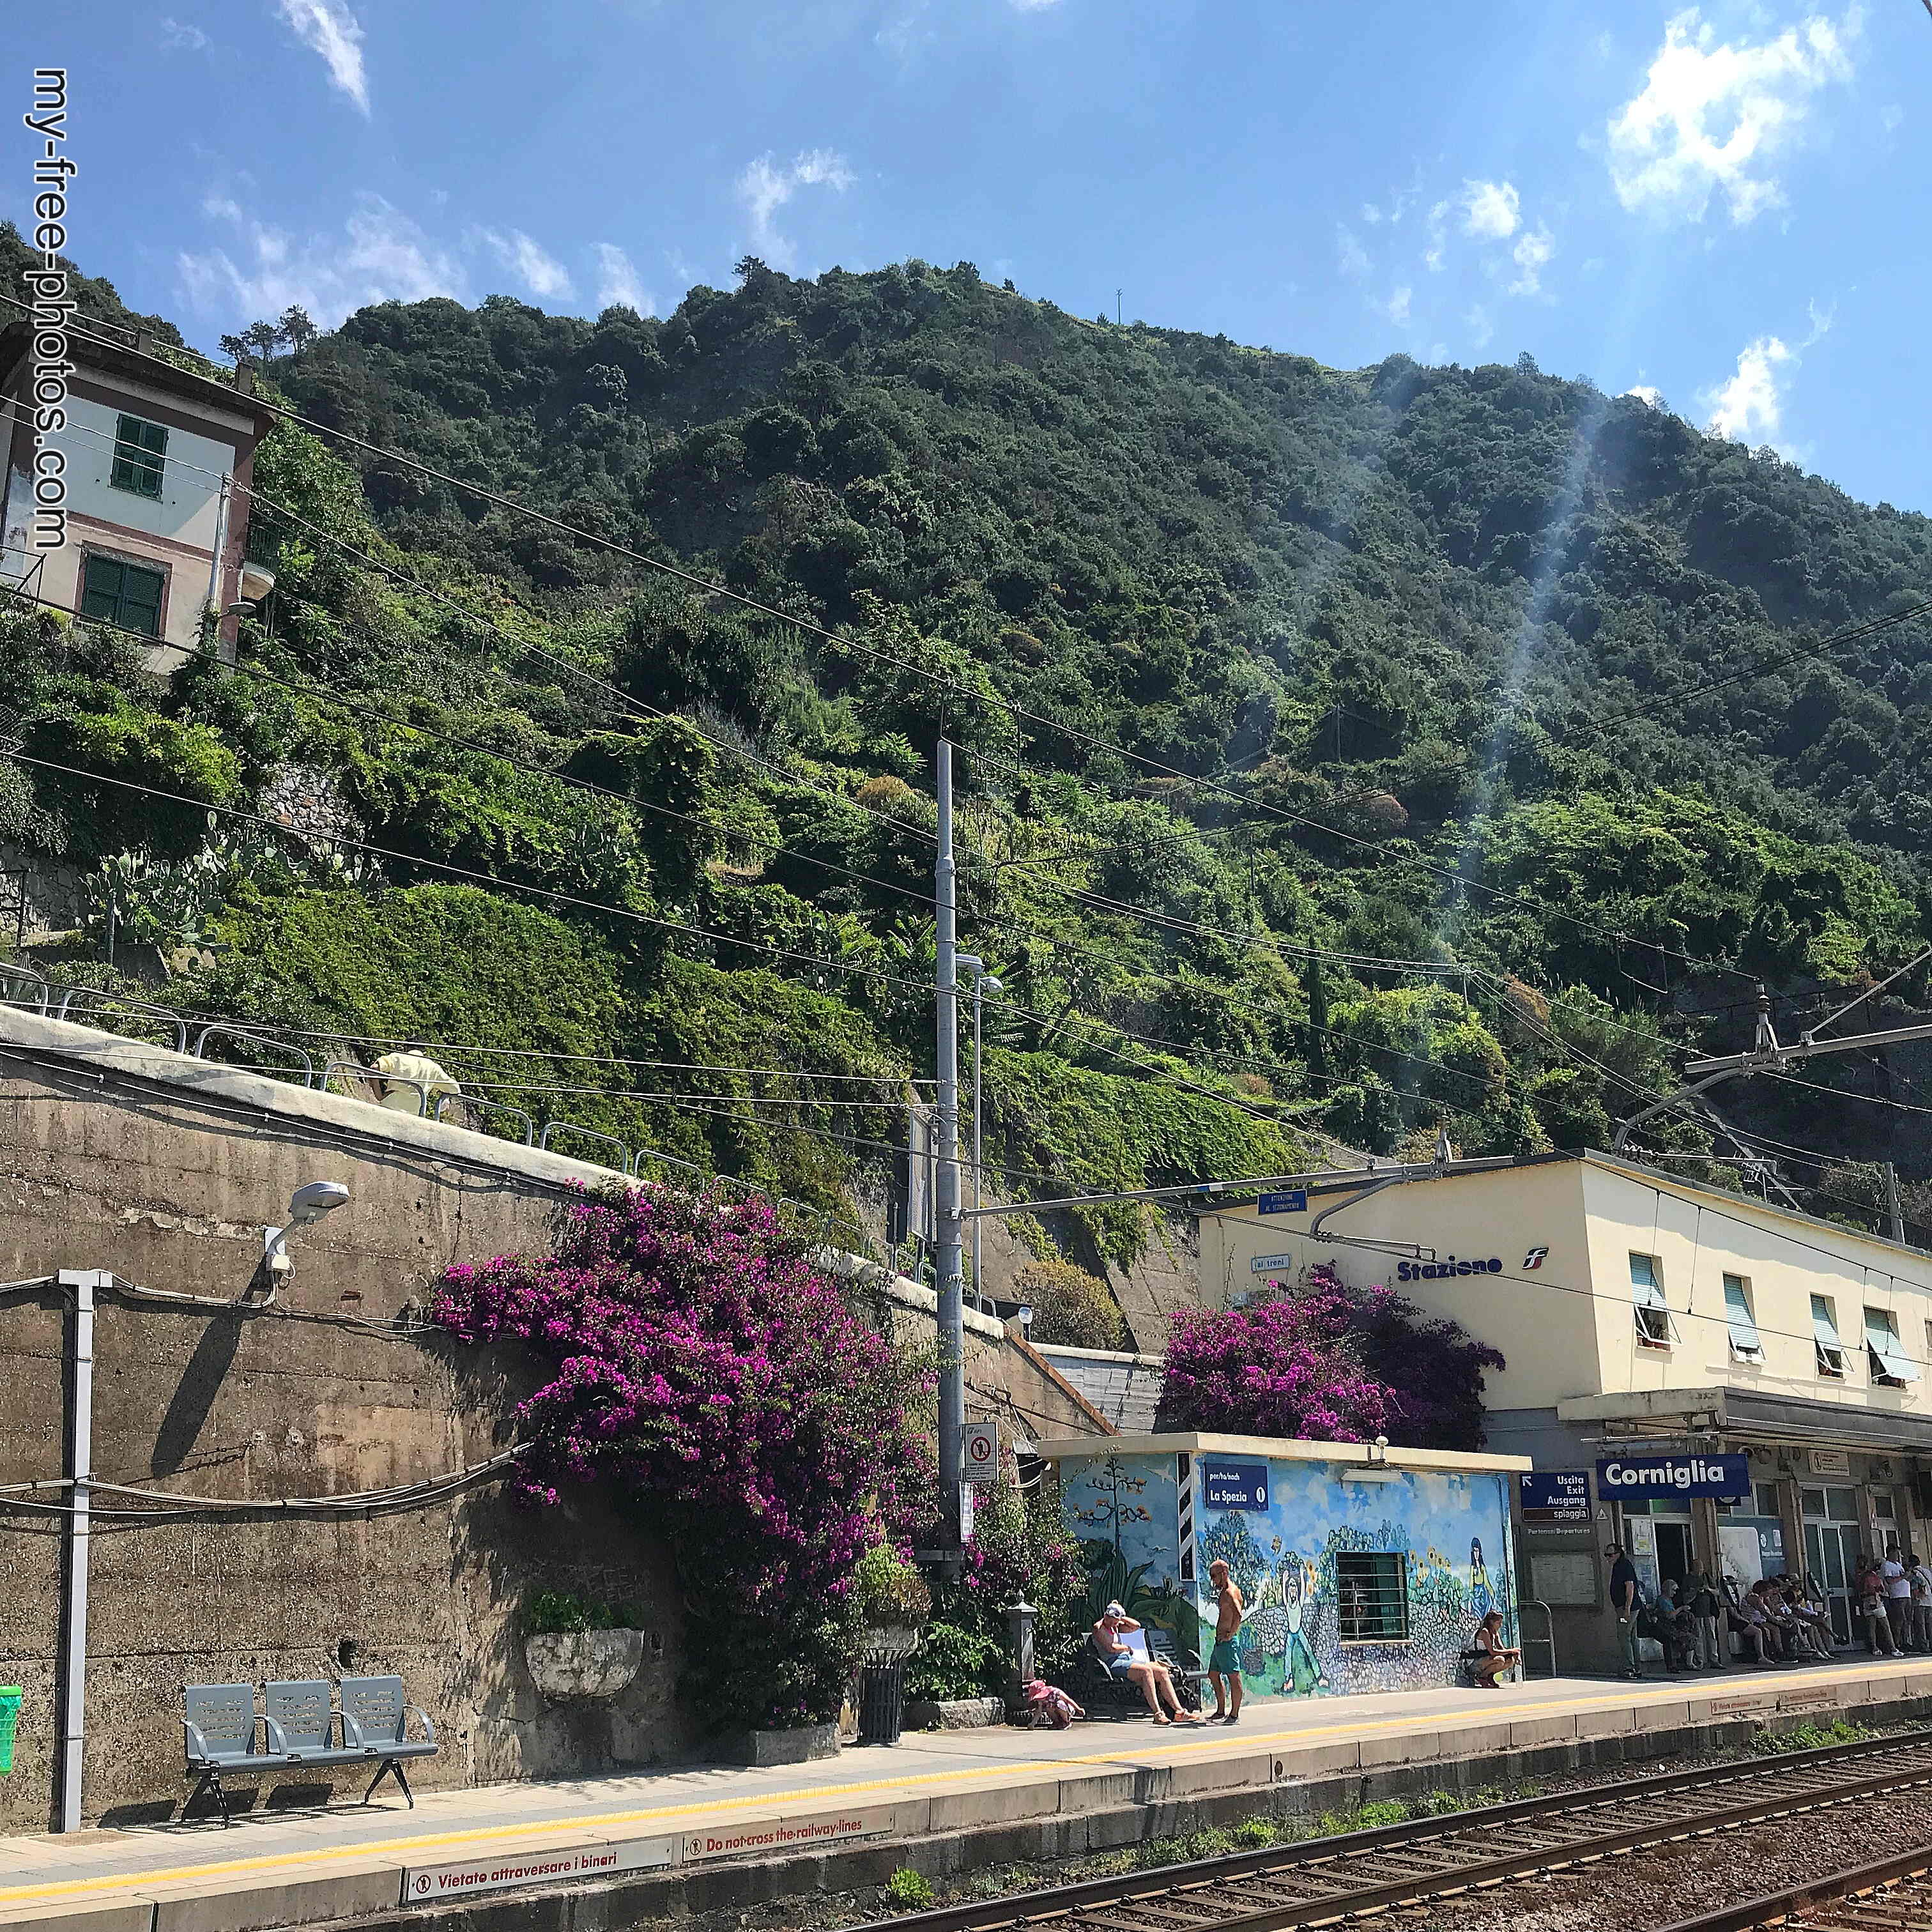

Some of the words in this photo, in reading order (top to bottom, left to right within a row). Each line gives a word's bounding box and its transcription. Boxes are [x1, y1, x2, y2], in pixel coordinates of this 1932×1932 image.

[1397, 1255, 1503, 1281] Stazione
[1557, 1475, 1584, 1484] Uscita
[1606, 1460, 1724, 1489] Corniglia
[1567, 1485, 1584, 1494] Exit
[1210, 1490, 1220, 1501] La
[1222, 1490, 1247, 1505] Spezia
[1547, 1496, 1586, 1506] Ausgang
[1554, 1508, 1586, 1519] spiaggia
[707, 1838, 723, 1852] Do
[725, 1836, 744, 1849] not
[746, 1832, 774, 1846] cross
[776, 1827, 794, 1841] the
[796, 1823, 837, 1840] railway
[838, 1820, 862, 1833] lines
[438, 1873, 487, 1889] Vietato
[491, 1859, 571, 1882] attraversare
[574, 1856, 578, 1870] i
[581, 1851, 617, 1869] binari
